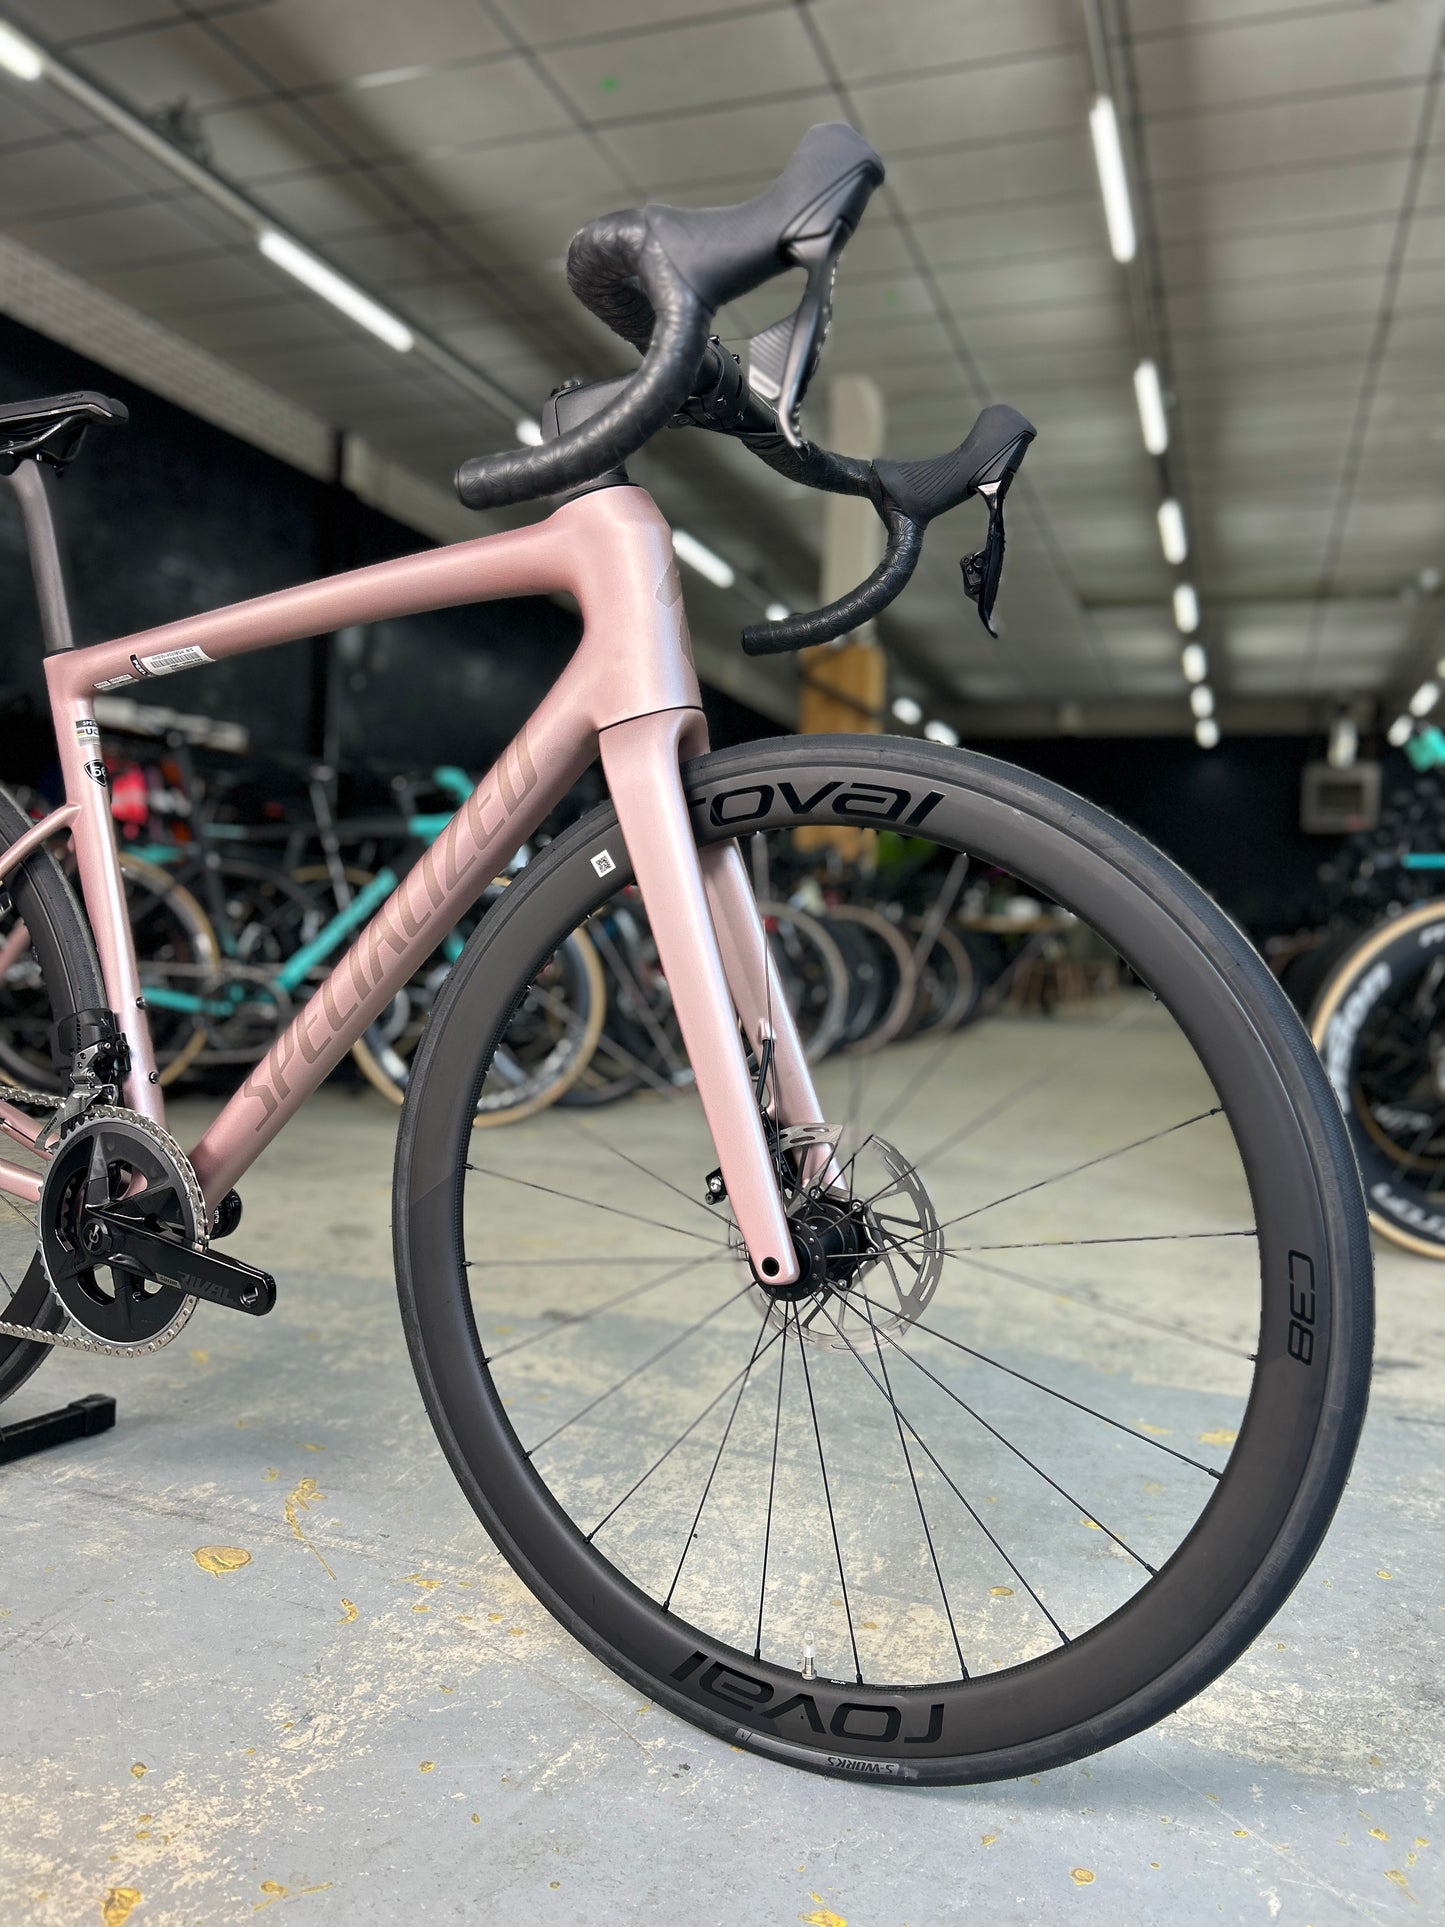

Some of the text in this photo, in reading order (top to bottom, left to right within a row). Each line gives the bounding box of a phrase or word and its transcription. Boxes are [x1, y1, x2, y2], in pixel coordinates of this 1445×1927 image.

[243, 723, 538, 1132] SPECIALIZED
[1287, 1249, 1316, 1366] C38
[827, 1756, 895, 1774] S-WORKS
